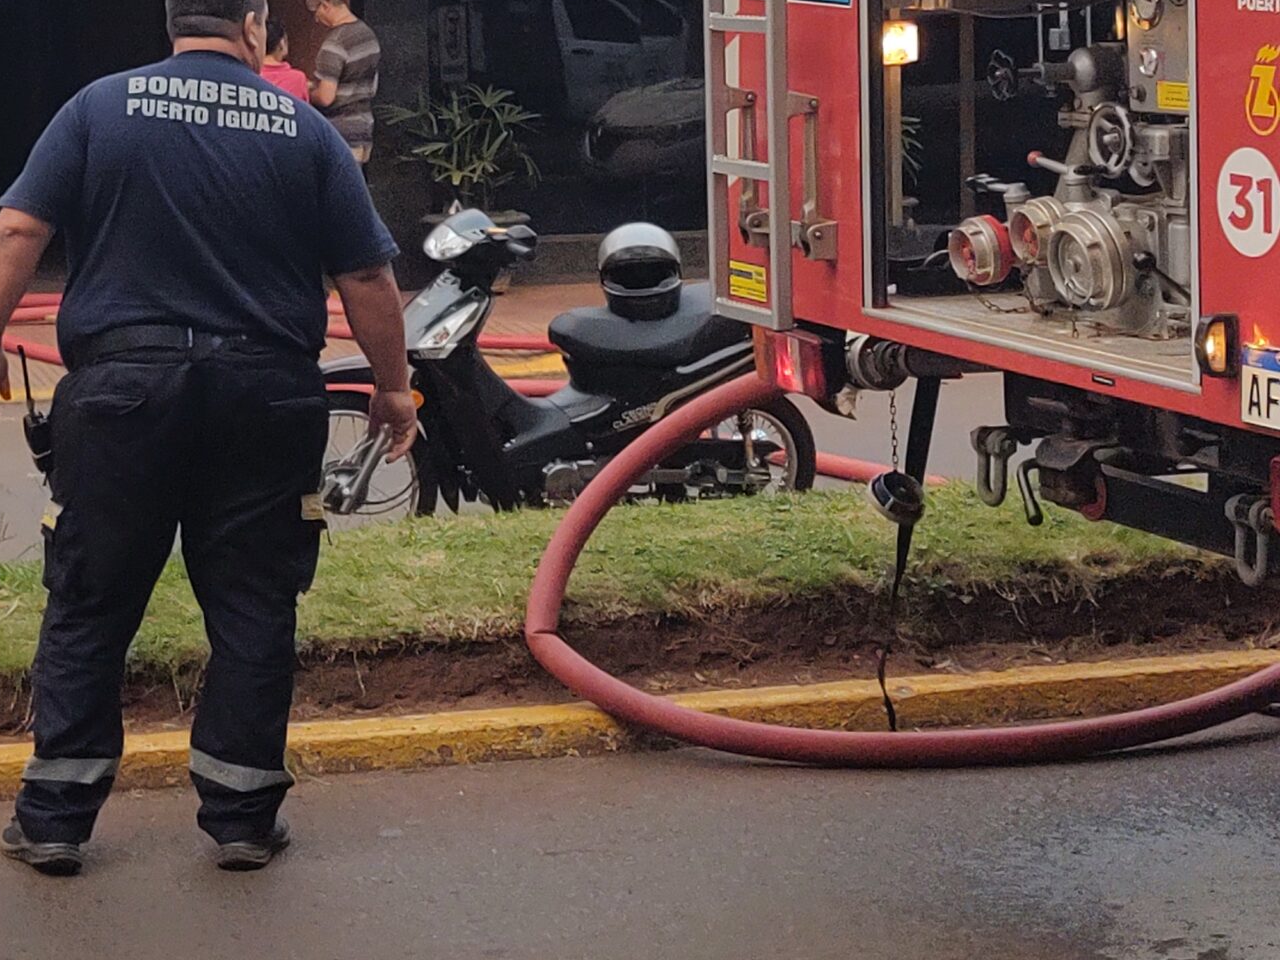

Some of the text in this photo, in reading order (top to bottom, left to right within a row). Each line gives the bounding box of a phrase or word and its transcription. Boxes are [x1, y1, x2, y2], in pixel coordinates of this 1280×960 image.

[127, 76, 296, 115] BOMBEROS
[126, 98, 298, 138] PUERTO IGUAZU
[1228, 172, 1273, 235] 31
[1248, 373, 1280, 419] AF
